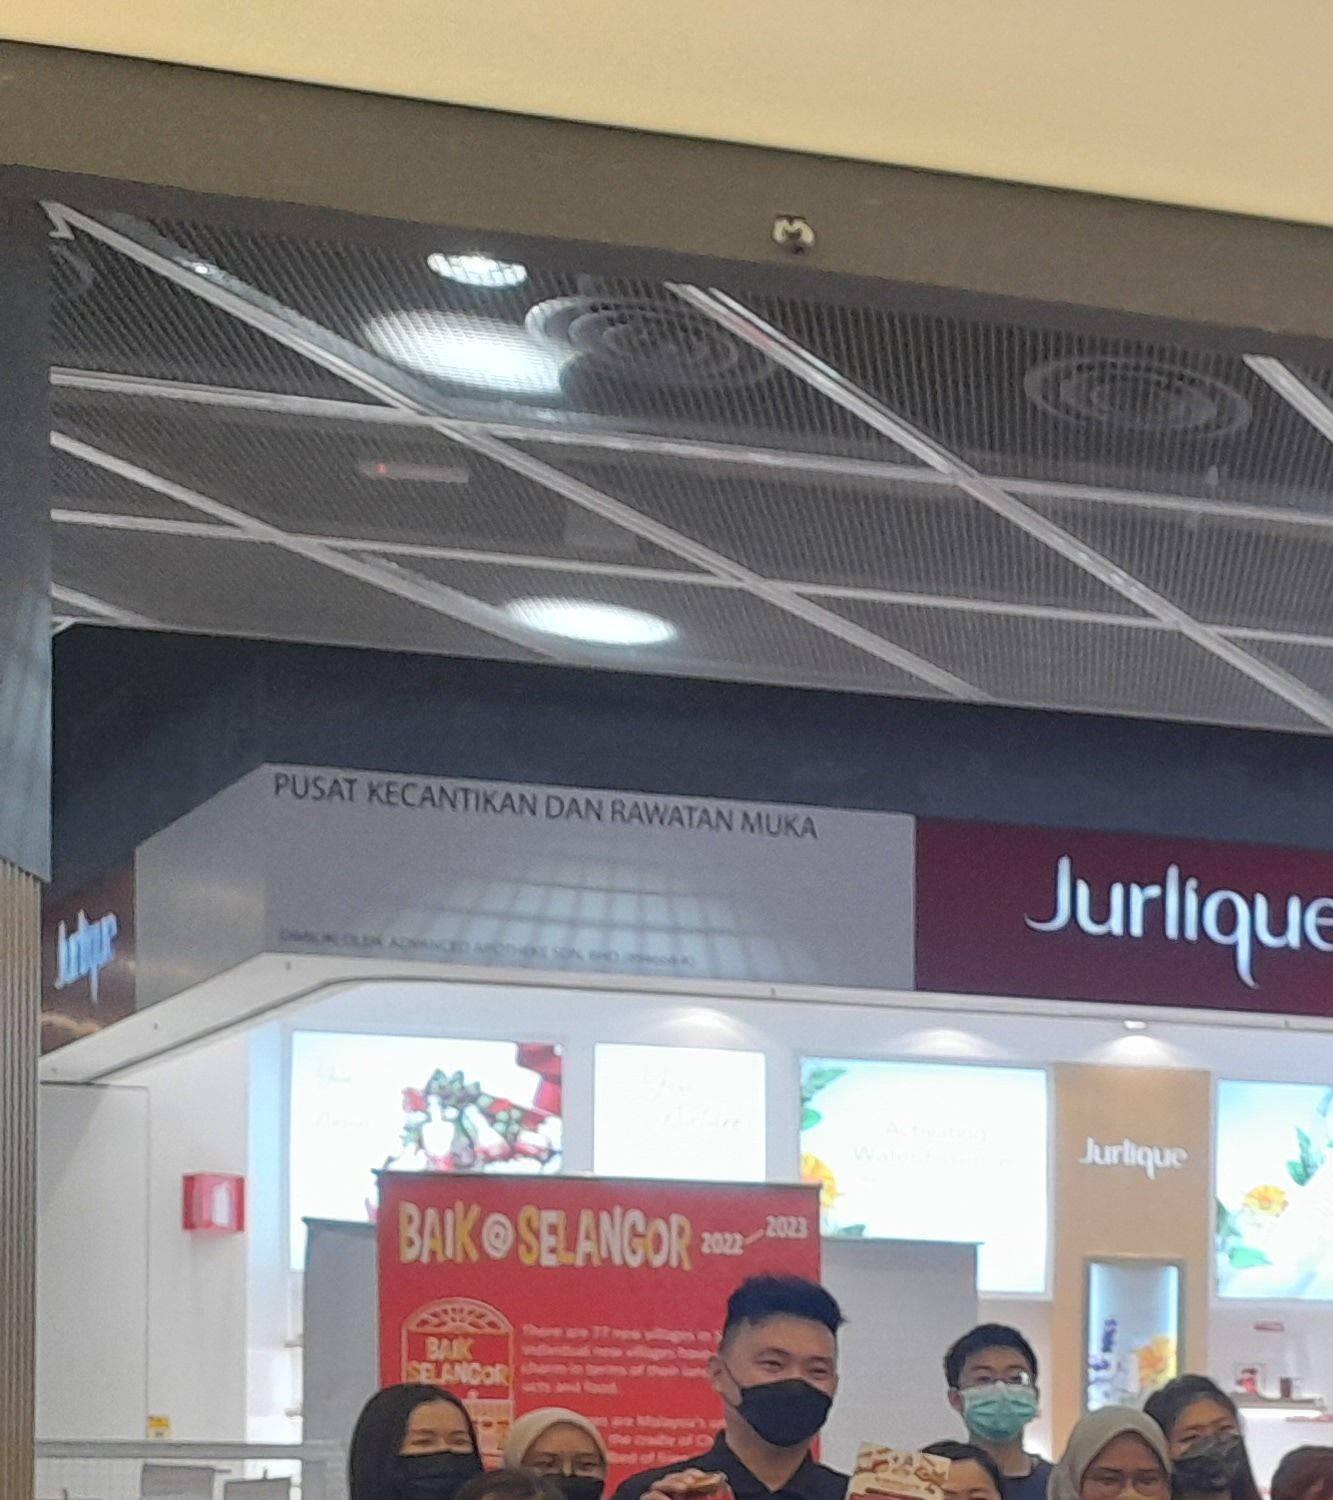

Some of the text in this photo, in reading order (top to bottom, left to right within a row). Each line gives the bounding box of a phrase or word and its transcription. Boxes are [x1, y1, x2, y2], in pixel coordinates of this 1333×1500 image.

[274, 772, 818, 840] PUSAT KECANTIKAN DAN RAWATAN MUKA
[1075, 1136, 1189, 1181] Jurlique
[400, 1200, 481, 1264] BAIK
[518, 1205, 693, 1272] SELANGOR
[426, 1336, 475, 1361] BAIK
[407, 1361, 513, 1387] SELANGOR
